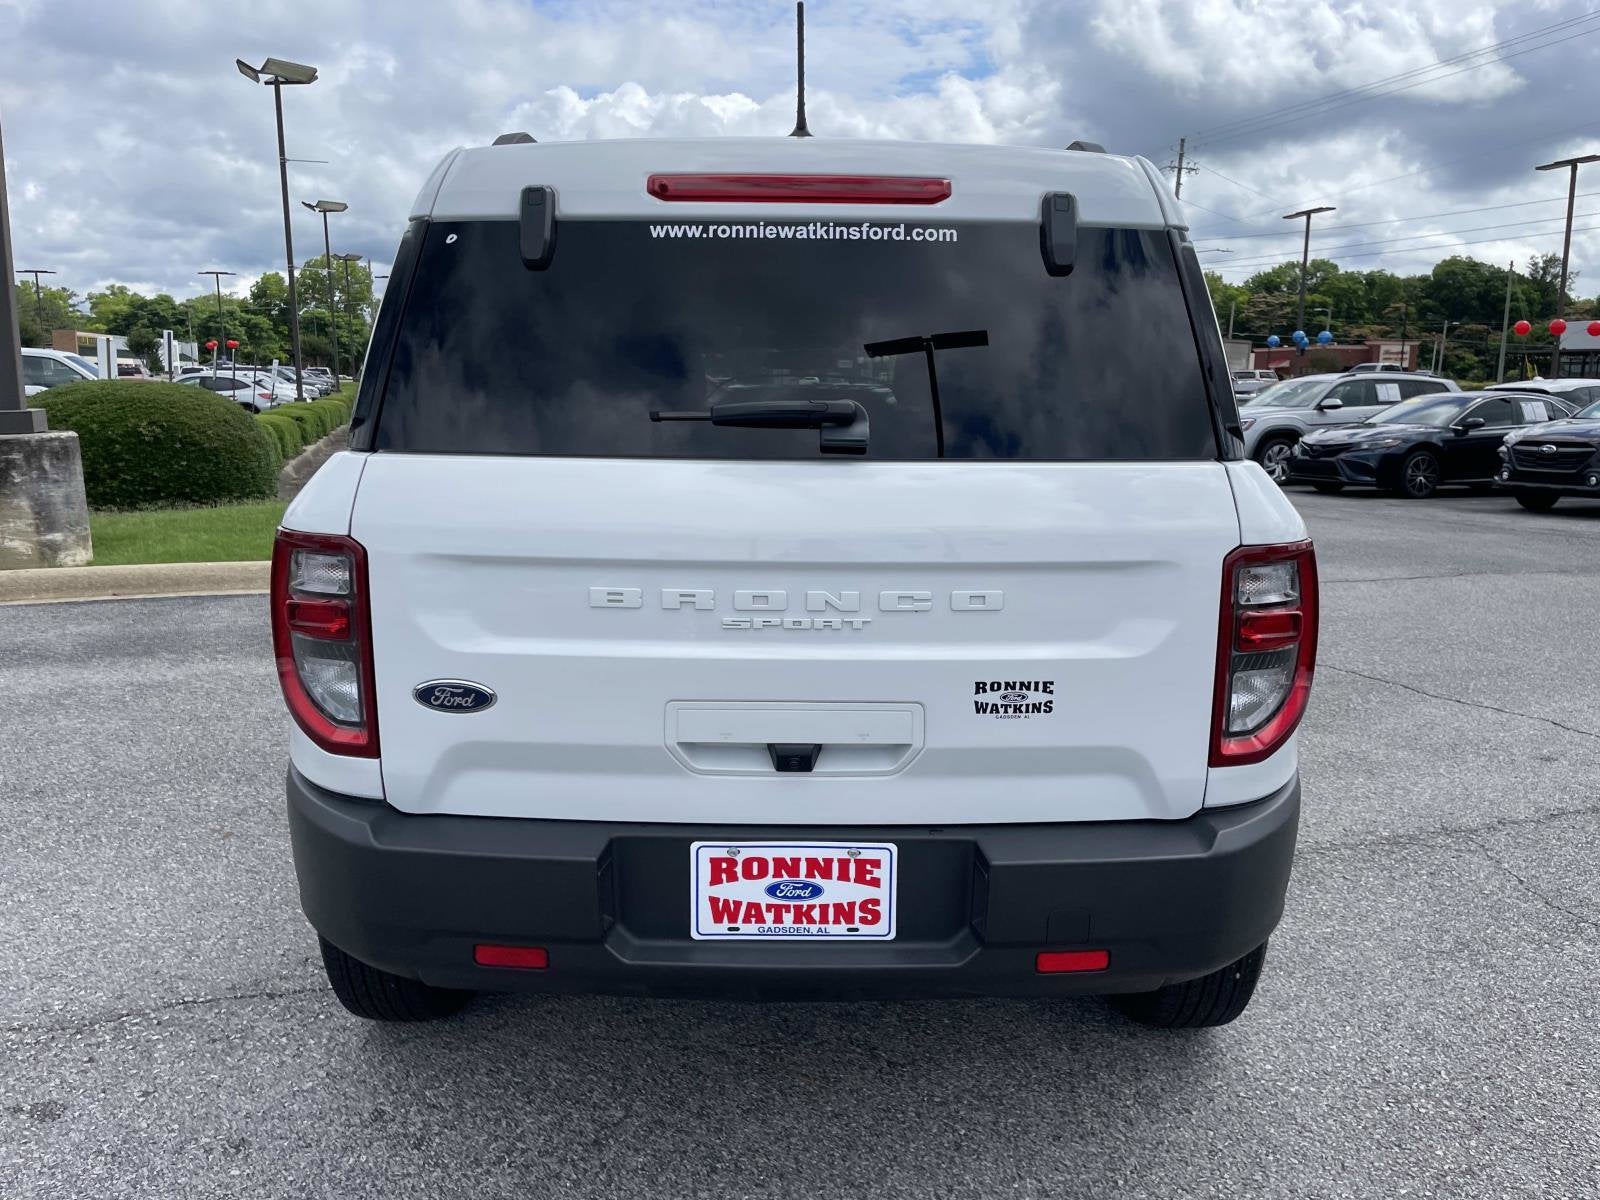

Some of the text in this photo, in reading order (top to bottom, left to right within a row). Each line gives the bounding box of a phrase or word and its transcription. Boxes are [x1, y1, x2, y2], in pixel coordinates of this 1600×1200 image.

[649, 221, 958, 242] www.ronniewatkinsford.com
[588, 586, 1005, 612] BRONCO
[721, 617, 872, 630] SPORT
[430, 686, 476, 707] Ford
[974, 680, 1055, 695] RONNIE
[973, 699, 1054, 714] WATKINS
[709, 856, 882, 889] RONNIE
[775, 883, 813, 898] Ford
[708, 895, 882, 926] WATKINS
[757, 926, 831, 935] GADSDEN, AL
